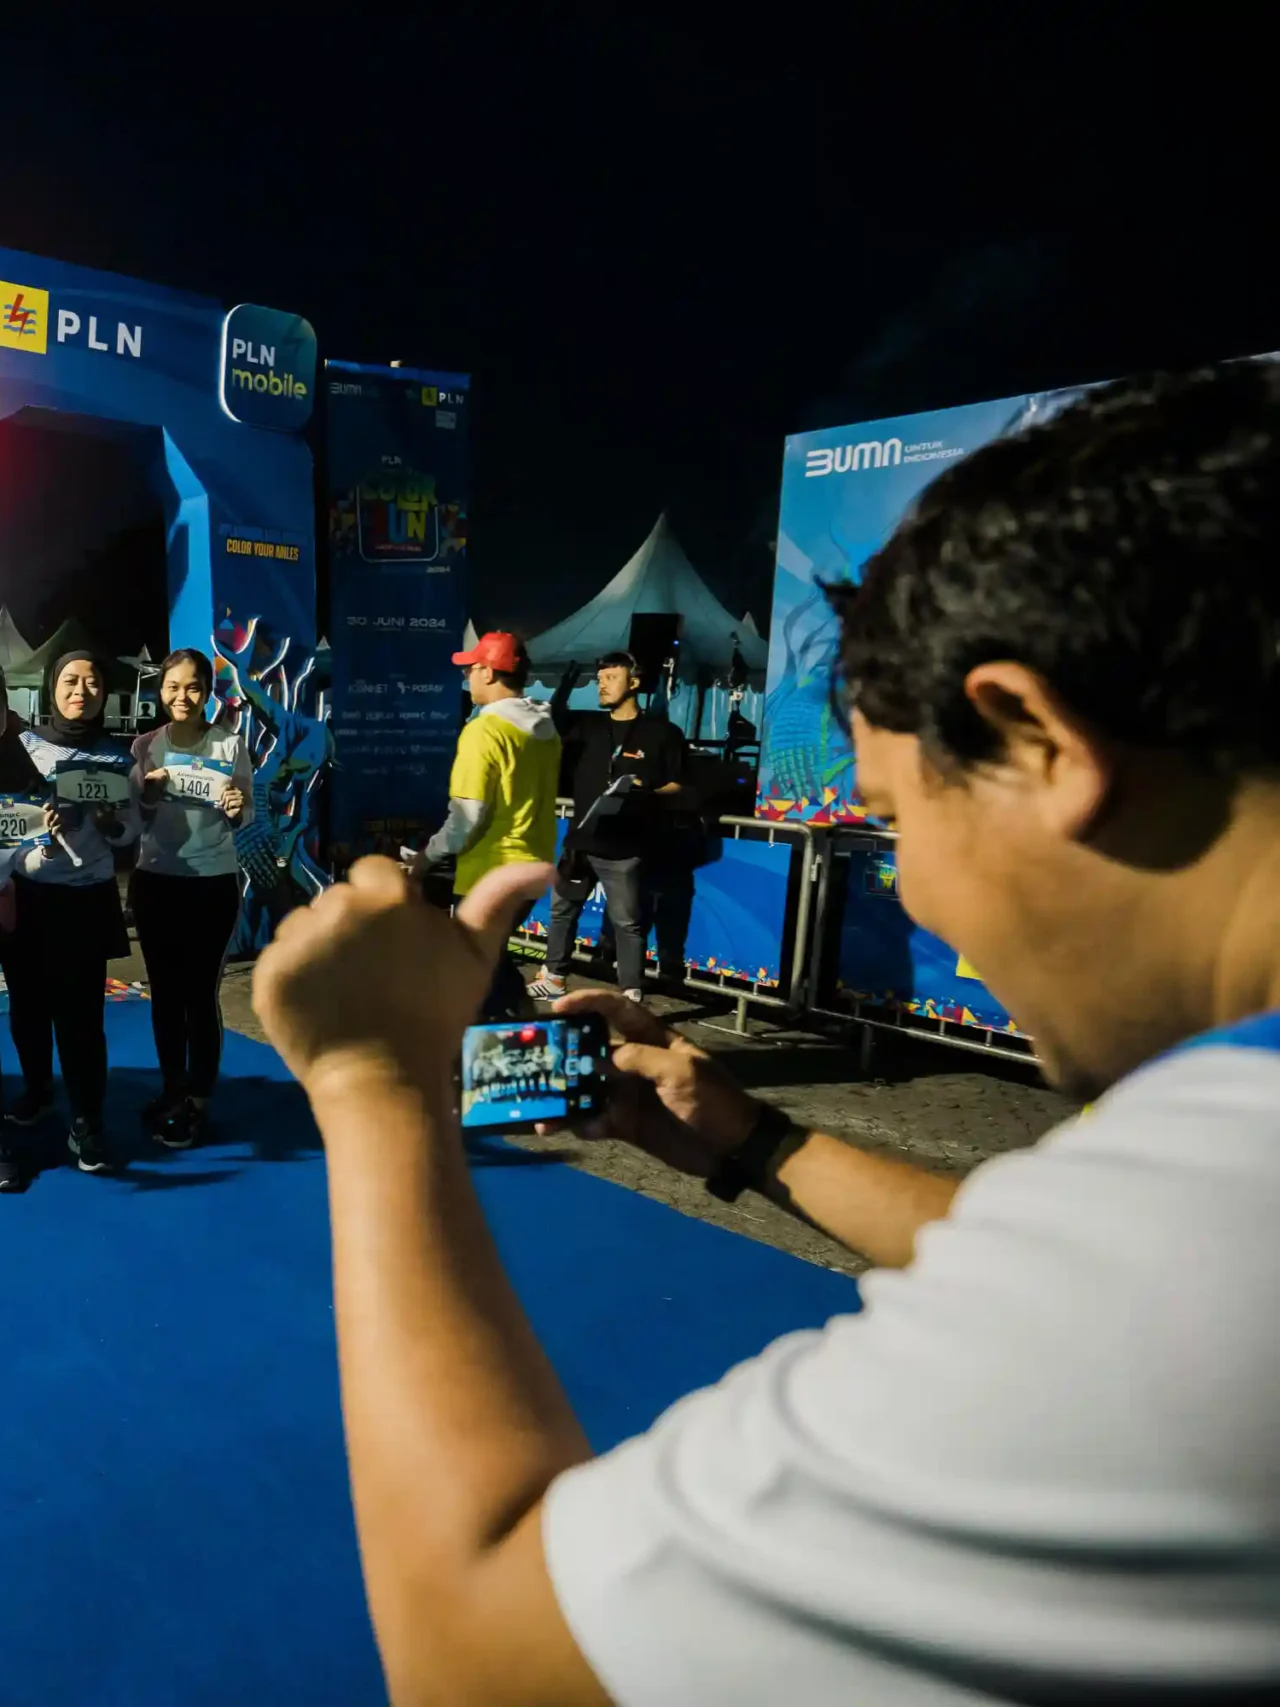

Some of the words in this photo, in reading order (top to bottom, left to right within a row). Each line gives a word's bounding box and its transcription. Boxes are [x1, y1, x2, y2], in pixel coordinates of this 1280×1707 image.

[57, 309, 142, 357] PLN
[232, 338, 275, 367] PLN
[231, 367, 307, 400] mobile
[438, 392, 464, 404] PLN
[903, 448, 965, 464] INDONESIA
[905, 441, 944, 453] UNTUK
[805, 438, 902, 478] BUMN
[226, 538, 252, 556] COLOR
[253, 541, 275, 558] YOUR
[275, 545, 299, 561] MILES
[372, 616, 405, 627] JUNI
[409, 618, 446, 628] 2024
[77, 783, 109, 799] 1221
[179, 777, 211, 797] 1404
